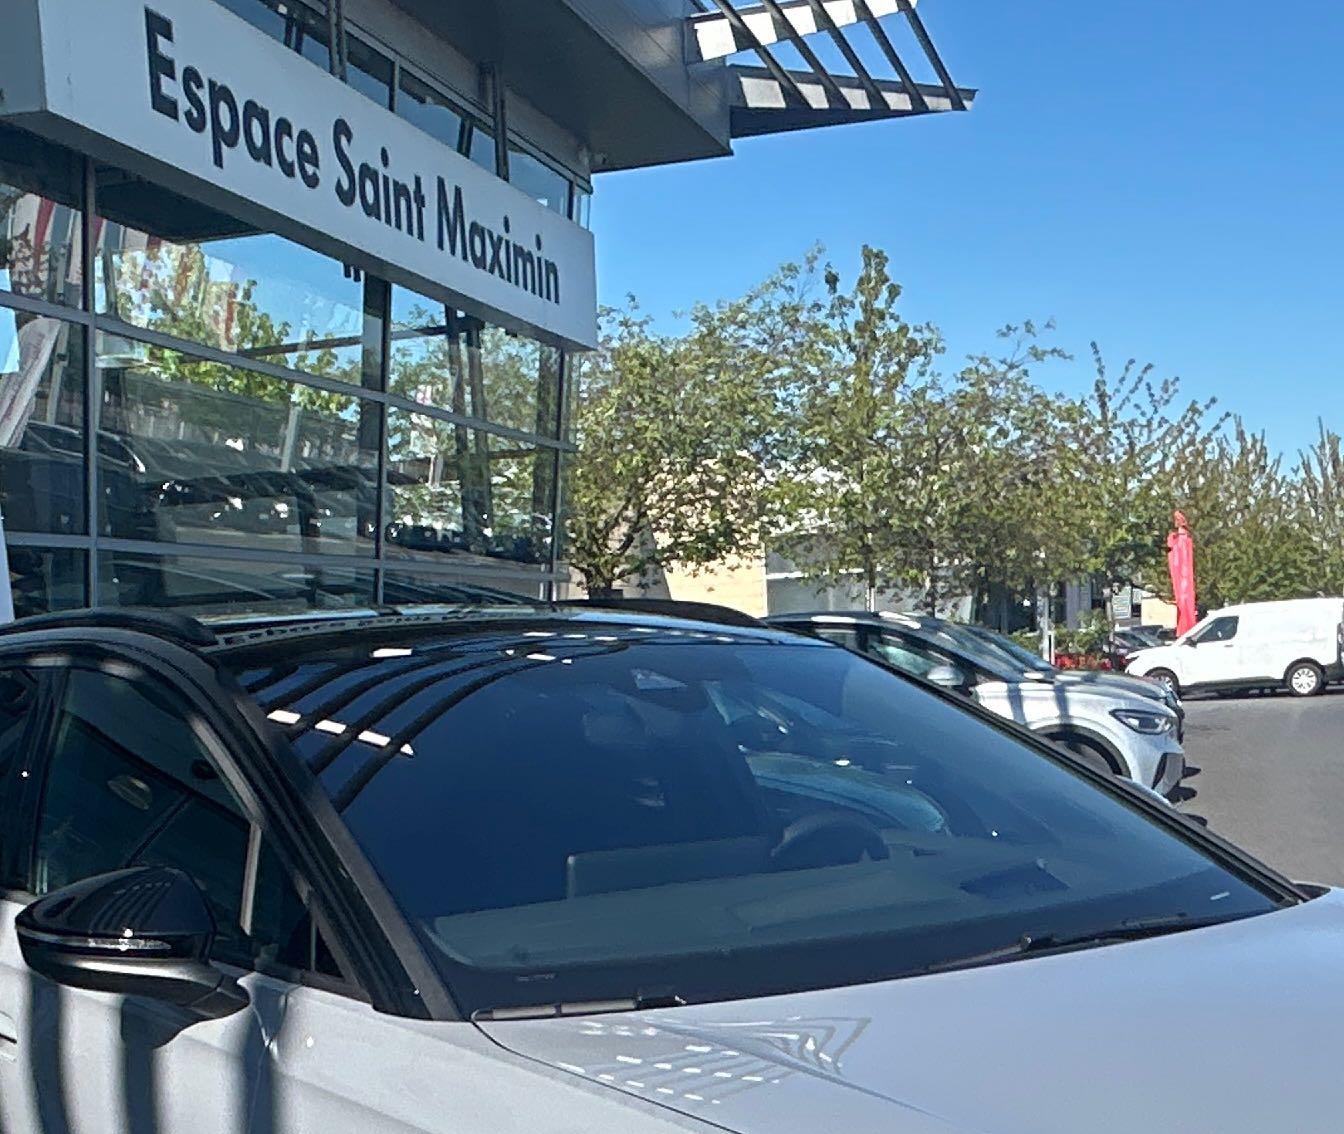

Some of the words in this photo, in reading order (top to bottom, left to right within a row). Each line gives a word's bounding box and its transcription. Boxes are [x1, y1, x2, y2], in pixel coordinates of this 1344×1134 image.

[144, 4, 320, 190] Espace
[333, 118, 426, 241] Saint
[436, 176, 561, 304] Maximin
